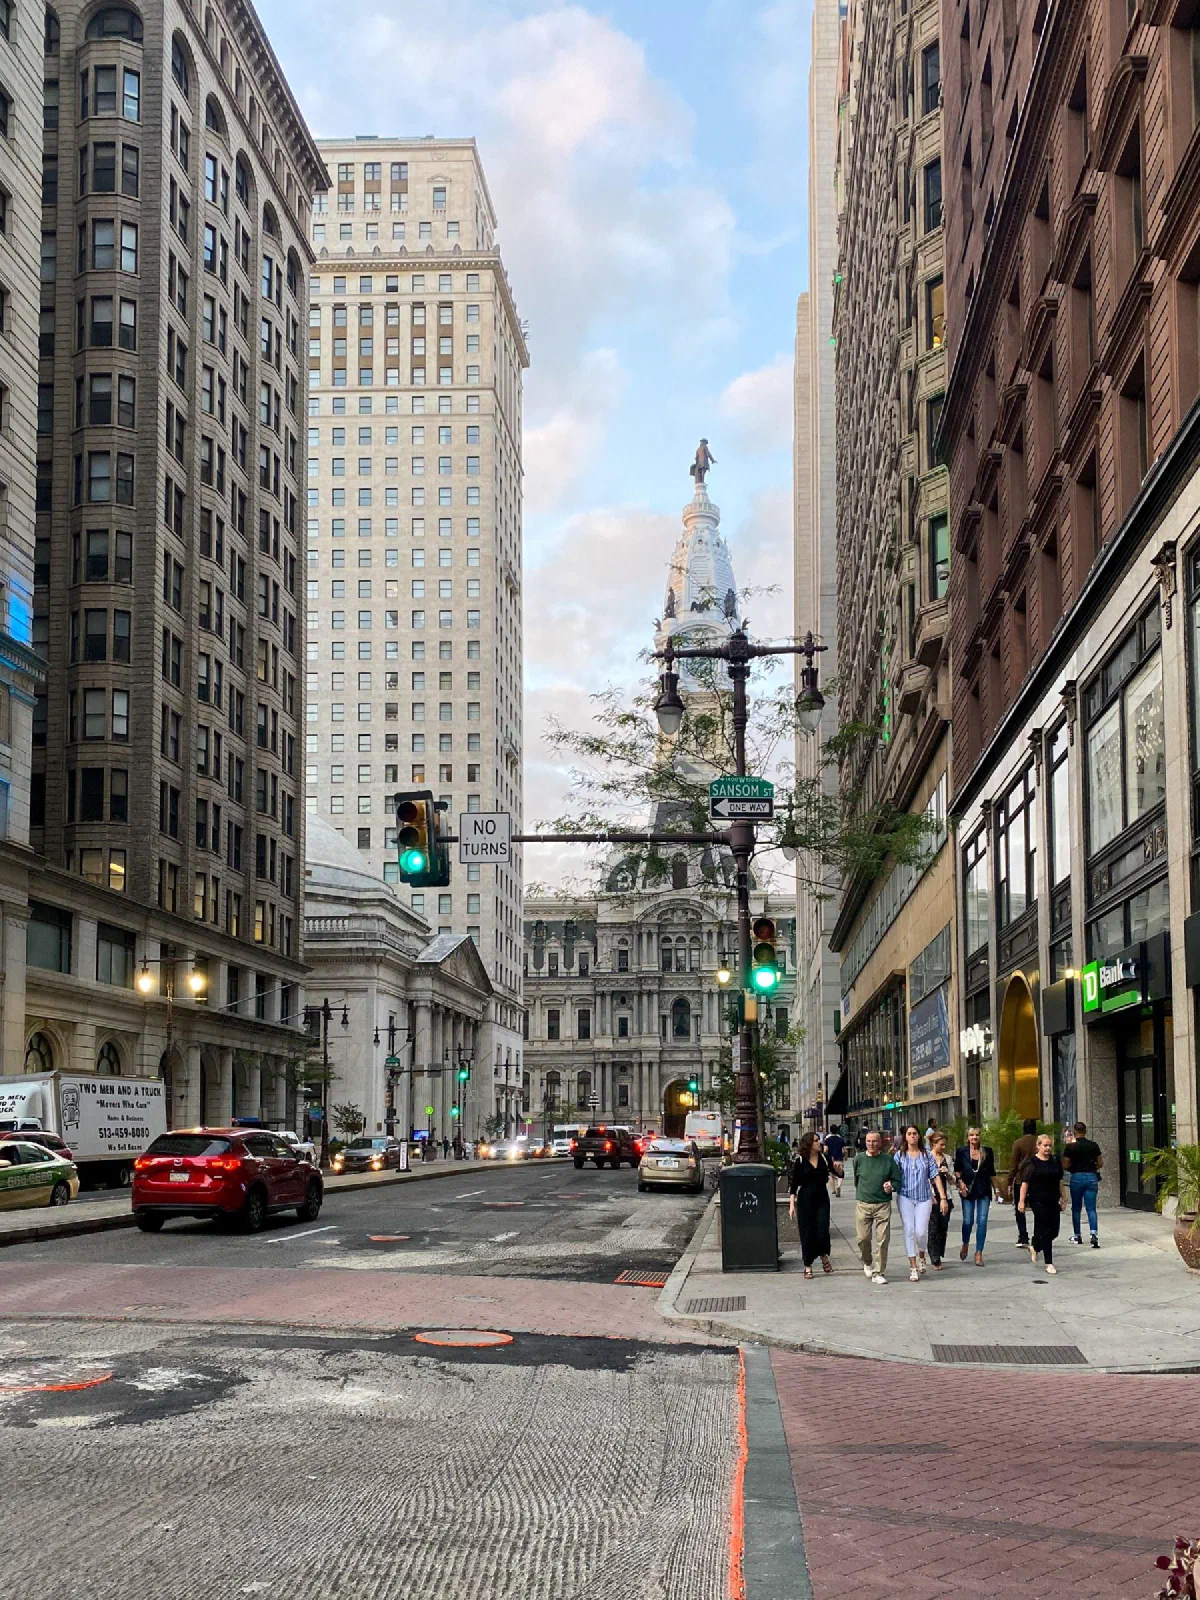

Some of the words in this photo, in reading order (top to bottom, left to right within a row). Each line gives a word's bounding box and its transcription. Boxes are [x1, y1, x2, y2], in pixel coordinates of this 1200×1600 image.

[712, 784, 759, 796] SANSOM
[763, 788, 773, 796] ST
[729, 803, 747, 812] ONE
[749, 803, 767, 812] WAY
[474, 819, 496, 835] NO
[462, 842, 507, 855] TURNS
[1084, 971, 1097, 1002] TD
[1099, 957, 1124, 988] Bank
[79, 1083, 97, 1094] TWO
[99, 1084, 115, 1095] MEN
[117, 1085, 132, 1096] AND
[134, 1086, 139, 1096] A
[141, 1087, 162, 1097] TRUCK
[122, 1100, 134, 1108] Who
[117, 1143, 127, 1151] Sell
